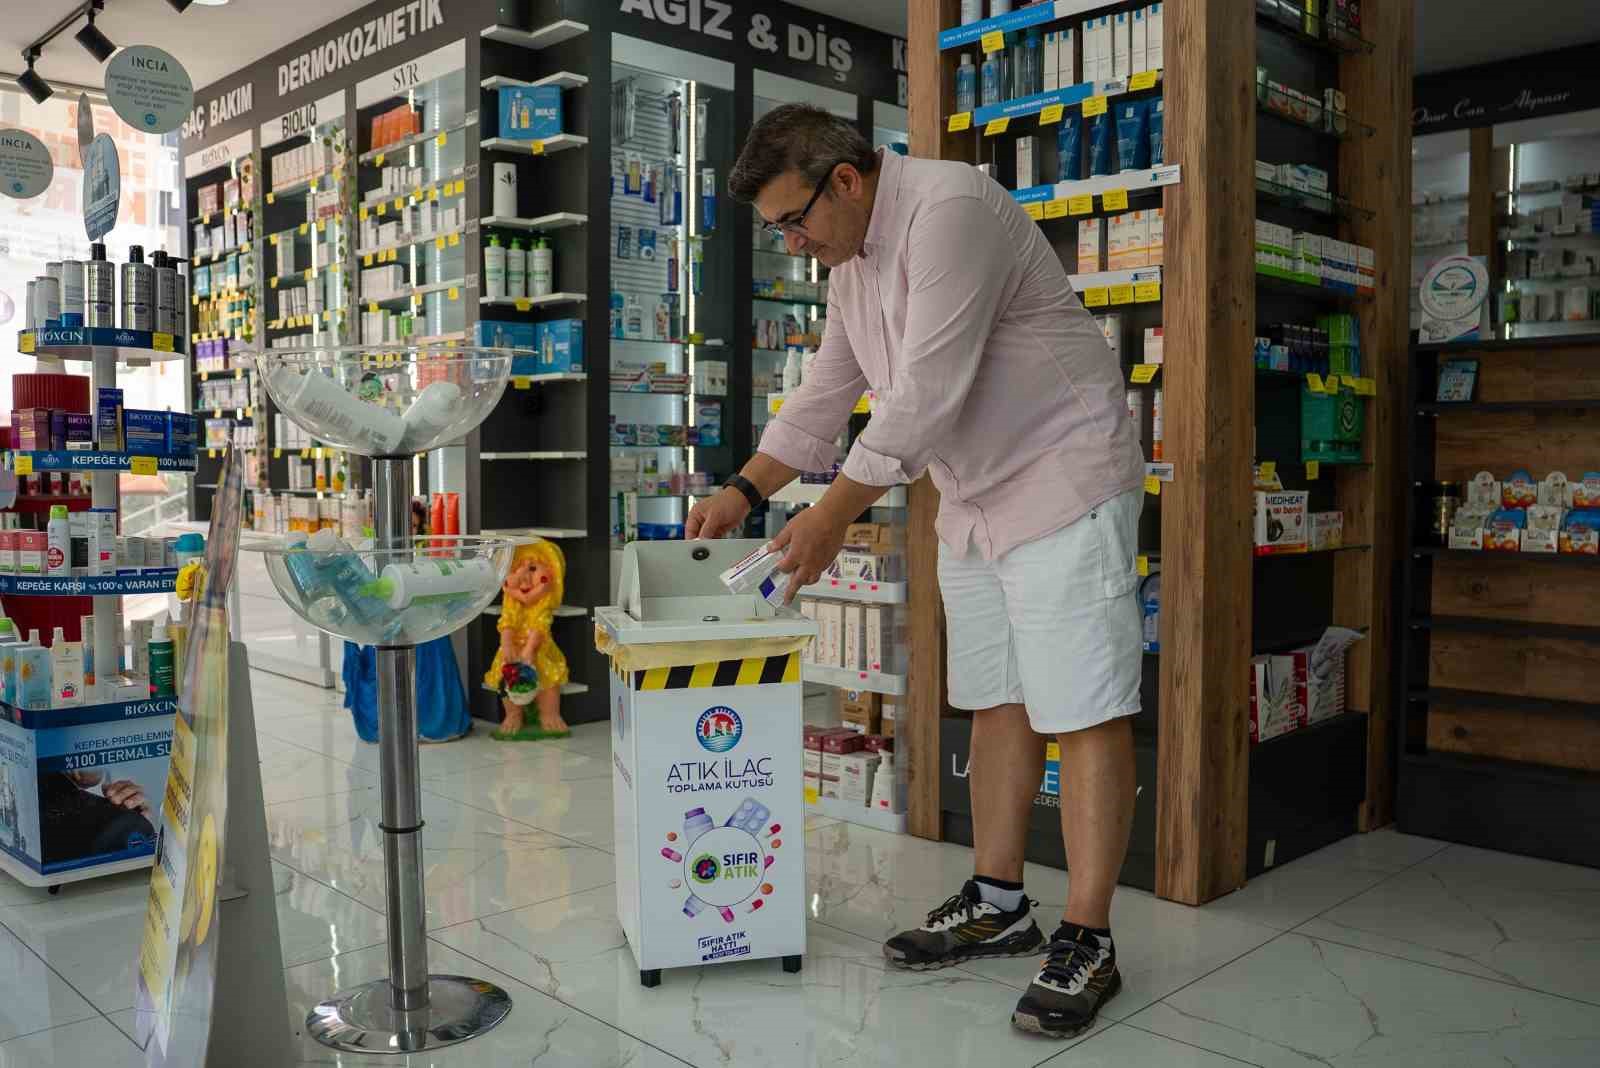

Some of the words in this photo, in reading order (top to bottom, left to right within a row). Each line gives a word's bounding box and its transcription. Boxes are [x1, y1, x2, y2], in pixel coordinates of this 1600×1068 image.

[747, 13, 778, 53] &
[788, 24, 853, 82] DİŞ
[131, 55, 169, 73] INCIA
[393, 63, 420, 92] SVR
[209, 82, 253, 127] BAKIM
[281, 101, 317, 139] BIOLIQ
[72, 455, 117, 465] KEPEĞE
[126, 580, 159, 589] VARAN
[65, 753, 96, 769] %100
[100, 744, 153, 763] TERMAL
[667, 760, 719, 782] ATIK
[724, 757, 773, 779] İLAÇ
[667, 782, 722, 793] TOPLAMA
[725, 776, 774, 789] KUTUSU
[723, 852, 758, 866] SIFIR
[724, 865, 758, 879] ATIK
[701, 936, 724, 949] SIFIR
[726, 930, 746, 942] ATIK
[711, 940, 737, 953] HATTI
